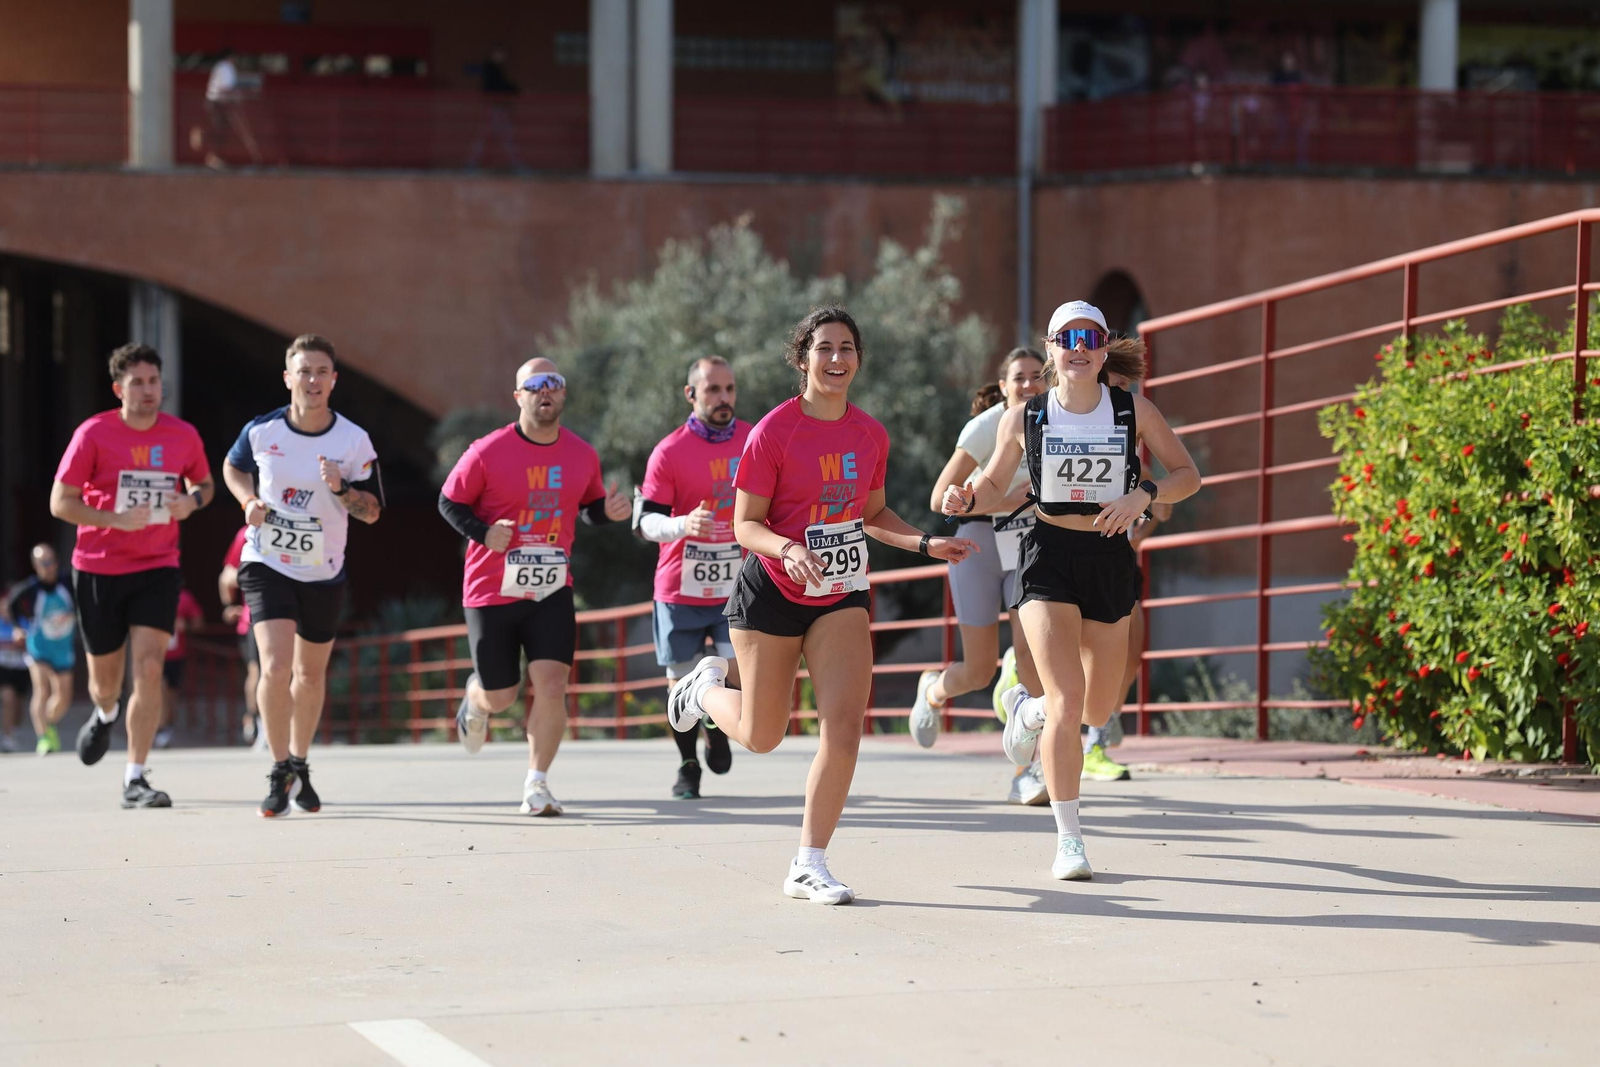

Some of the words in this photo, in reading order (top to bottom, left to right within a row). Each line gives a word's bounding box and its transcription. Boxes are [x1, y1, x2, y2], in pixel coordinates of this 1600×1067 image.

[131, 445, 164, 467] WE
[1047, 444, 1084, 454] UMA
[818, 452, 858, 482] WE
[1056, 458, 1113, 483] 422
[526, 465, 563, 490] WE
[820, 484, 856, 502] RUN
[1071, 491, 1084, 499] WE
[267, 515, 291, 529] UMA
[999, 519, 1025, 531] MA
[271, 528, 314, 552] 226
[810, 535, 841, 548] UMA
[509, 555, 539, 564] UMA
[820, 545, 862, 577] 299
[516, 566, 558, 587] 656
[693, 562, 733, 582] 681
